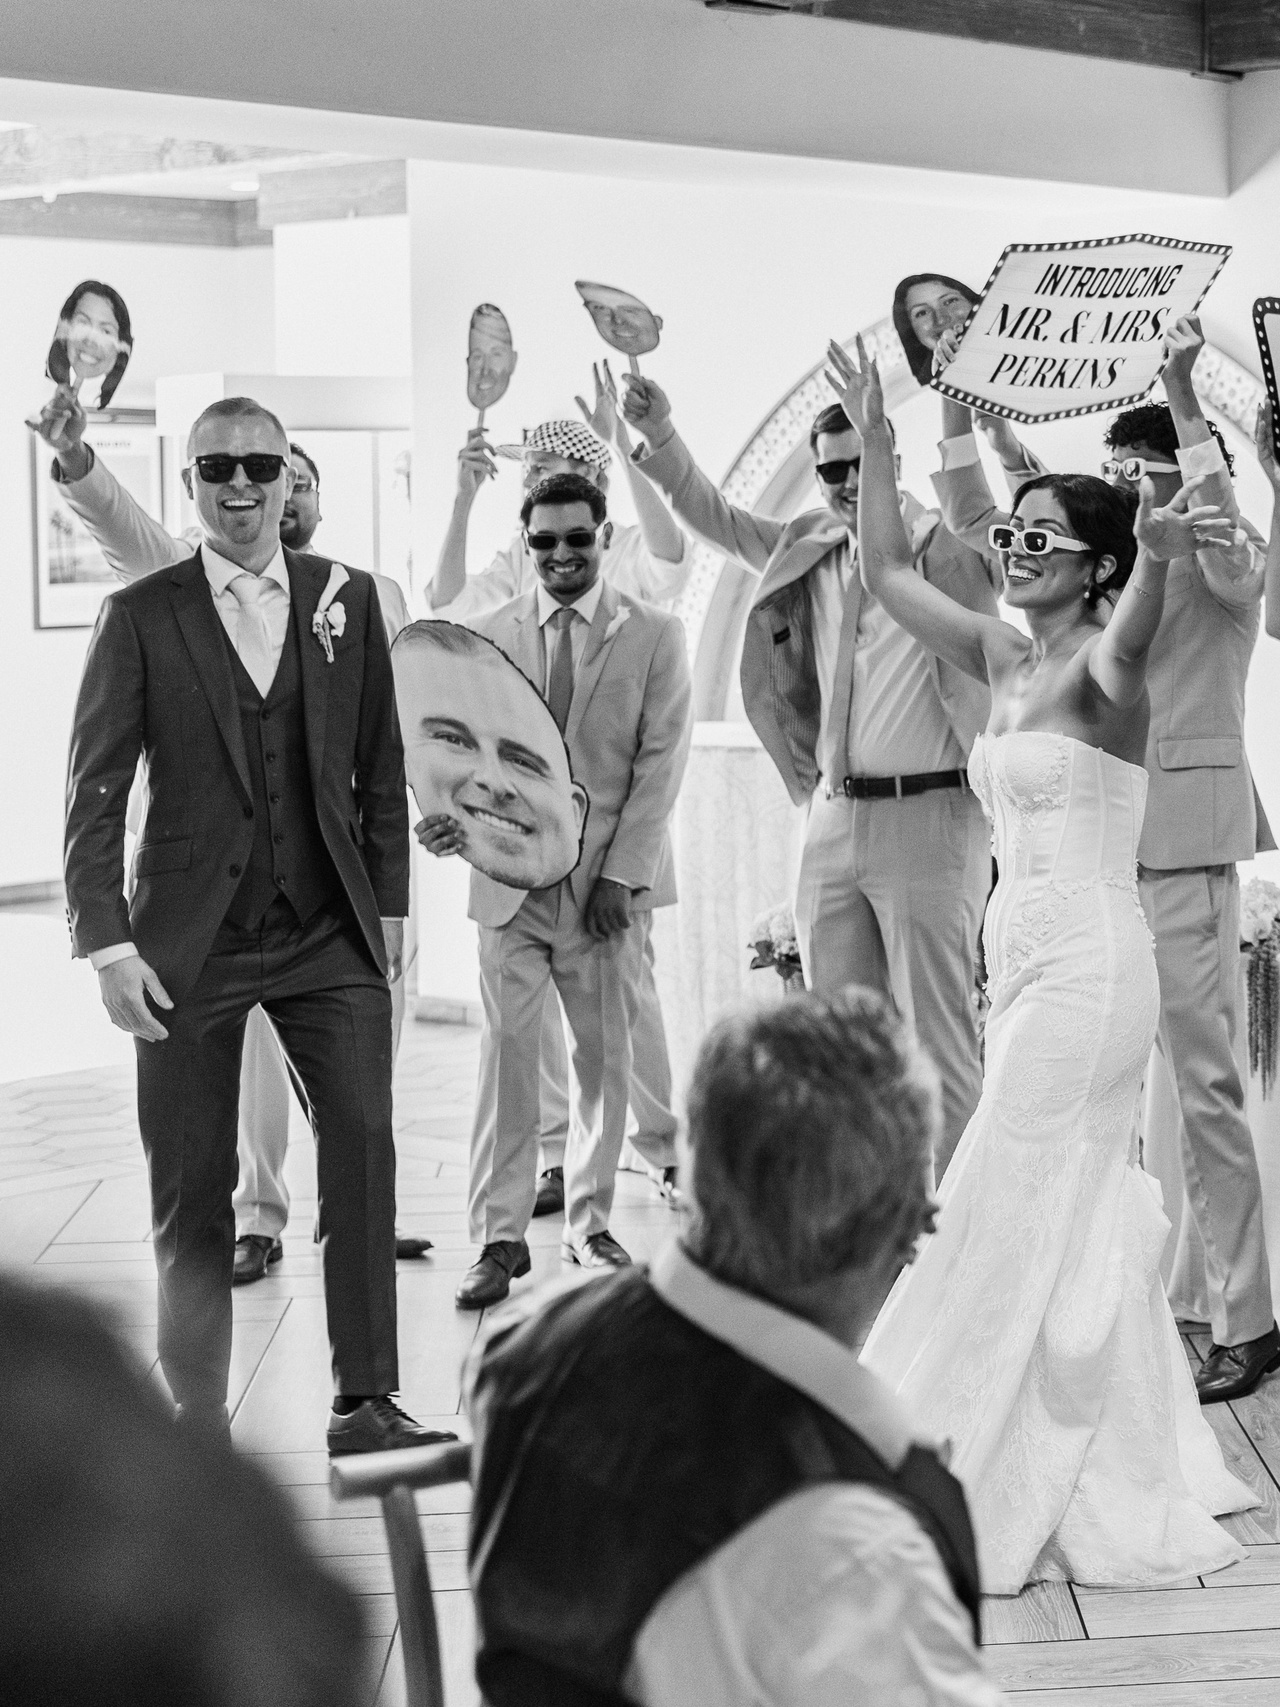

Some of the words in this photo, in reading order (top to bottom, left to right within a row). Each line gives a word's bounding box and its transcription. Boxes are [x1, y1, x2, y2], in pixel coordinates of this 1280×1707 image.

[1034, 263, 1183, 299] INTRODUCING
[984, 303, 1052, 342] MR.
[1059, 310, 1091, 344] &
[1089, 307, 1172, 344] MRS.
[987, 353, 1126, 389] PERKINS
